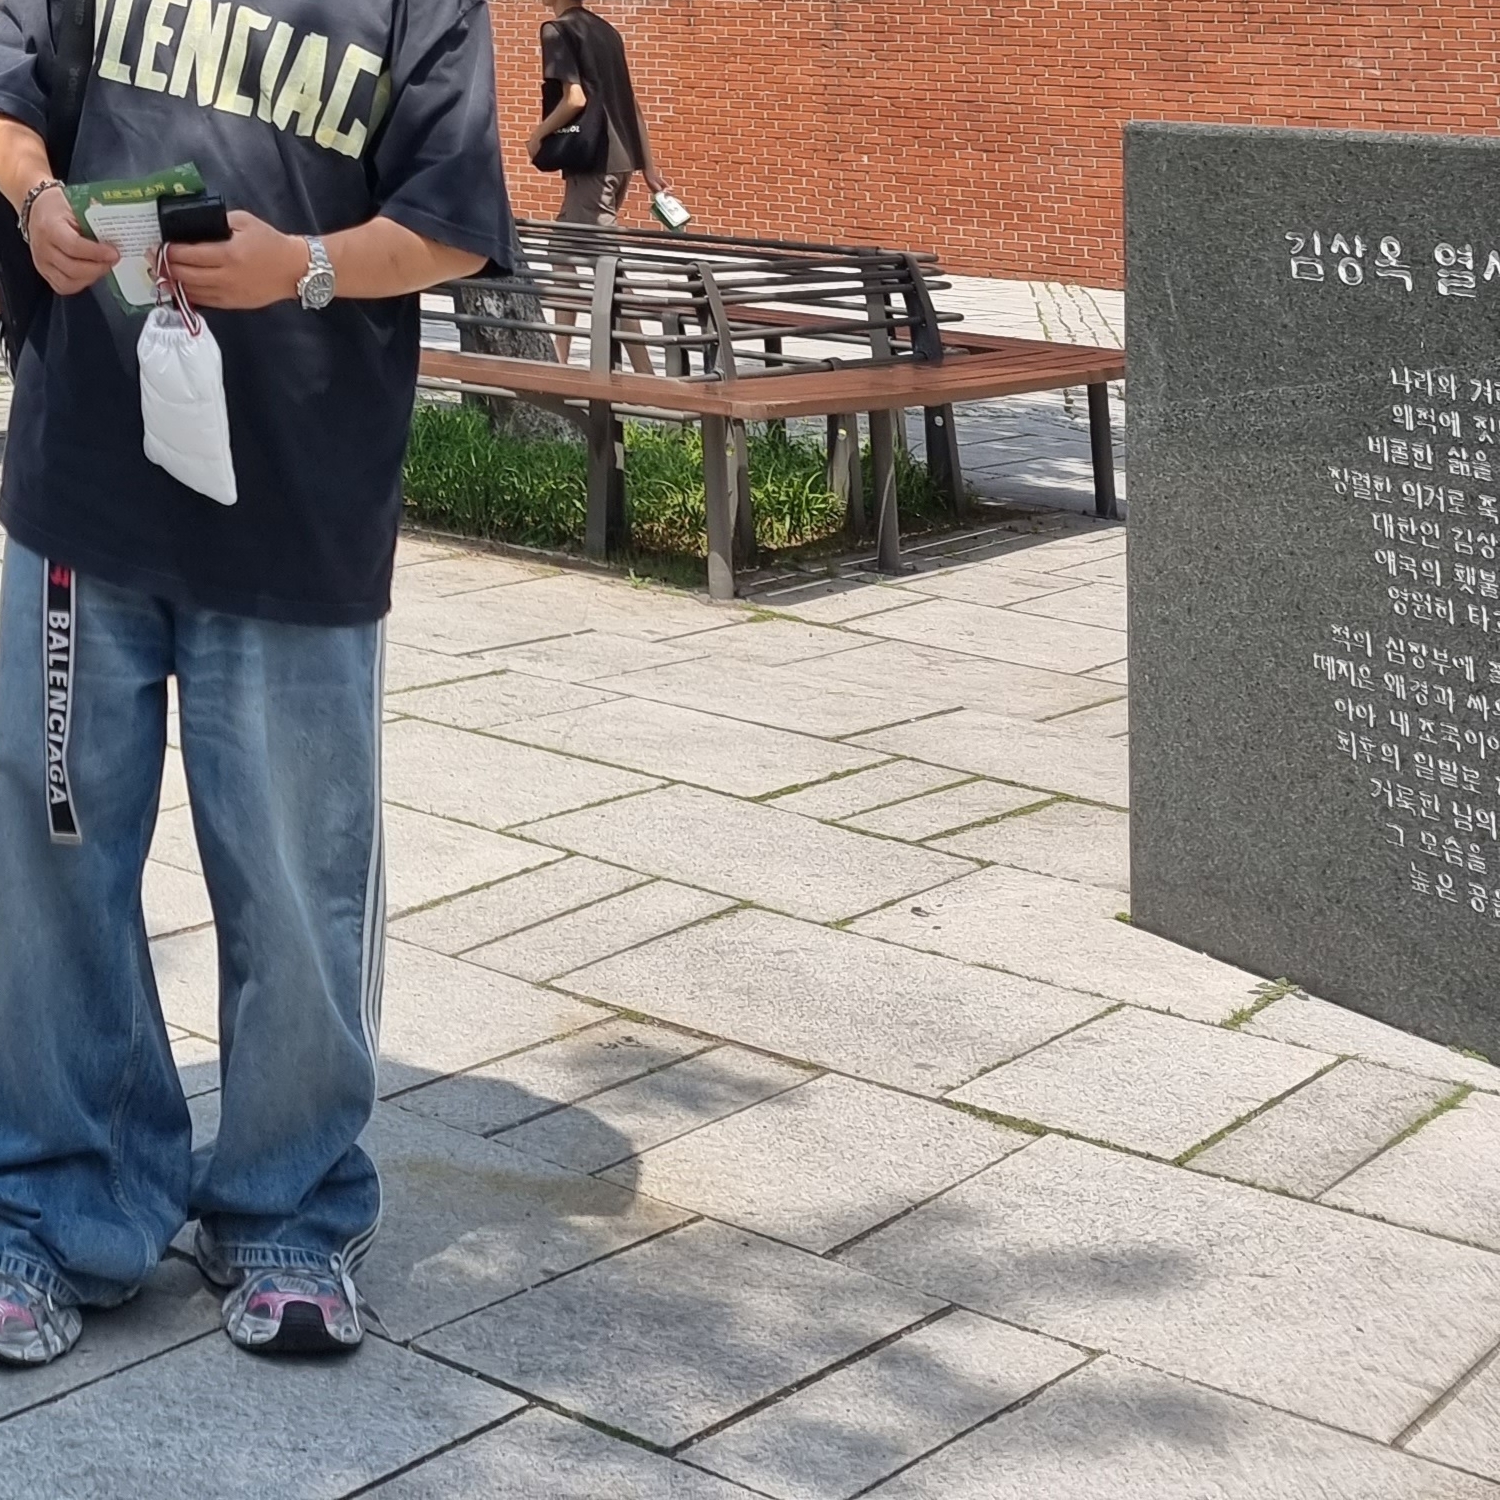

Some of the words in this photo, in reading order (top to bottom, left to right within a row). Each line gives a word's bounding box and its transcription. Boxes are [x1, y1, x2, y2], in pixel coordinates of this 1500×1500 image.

[1285, 230, 1413, 292] 김상옥
[1390, 366, 1457, 401] 나라와
[1392, 404, 1461, 438] 왜적에
[1472, 415, 1500, 444] 짓
[1368, 435, 1434, 470] 비굴한
[1447, 446, 1494, 482] 삶을
[1327, 465, 1393, 504] 장렬한
[1402, 480, 1468, 515] 의거로
[1371, 512, 1440, 549] 대한인
[1374, 550, 1442, 587] 애국의
[1387, 585, 1455, 625] 영원히
[1331, 624, 1372, 658] 적의
[1385, 636, 1475, 683] 심장부에
[1313, 652, 1376, 691] 떼지은
[1383, 672, 1456, 714] 왜경과
[48, 611, 70, 805] BALENCIAGA
[1334, 698, 1377, 728] 아아
[1389, 709, 1410, 737] 내
[1337, 729, 1400, 772] 최후의
[1413, 751, 1482, 795] 일발로
[1370, 778, 1441, 821] 거룩한
[1452, 801, 1498, 841] 님의
[1419, 831, 1488, 875] 모습을
